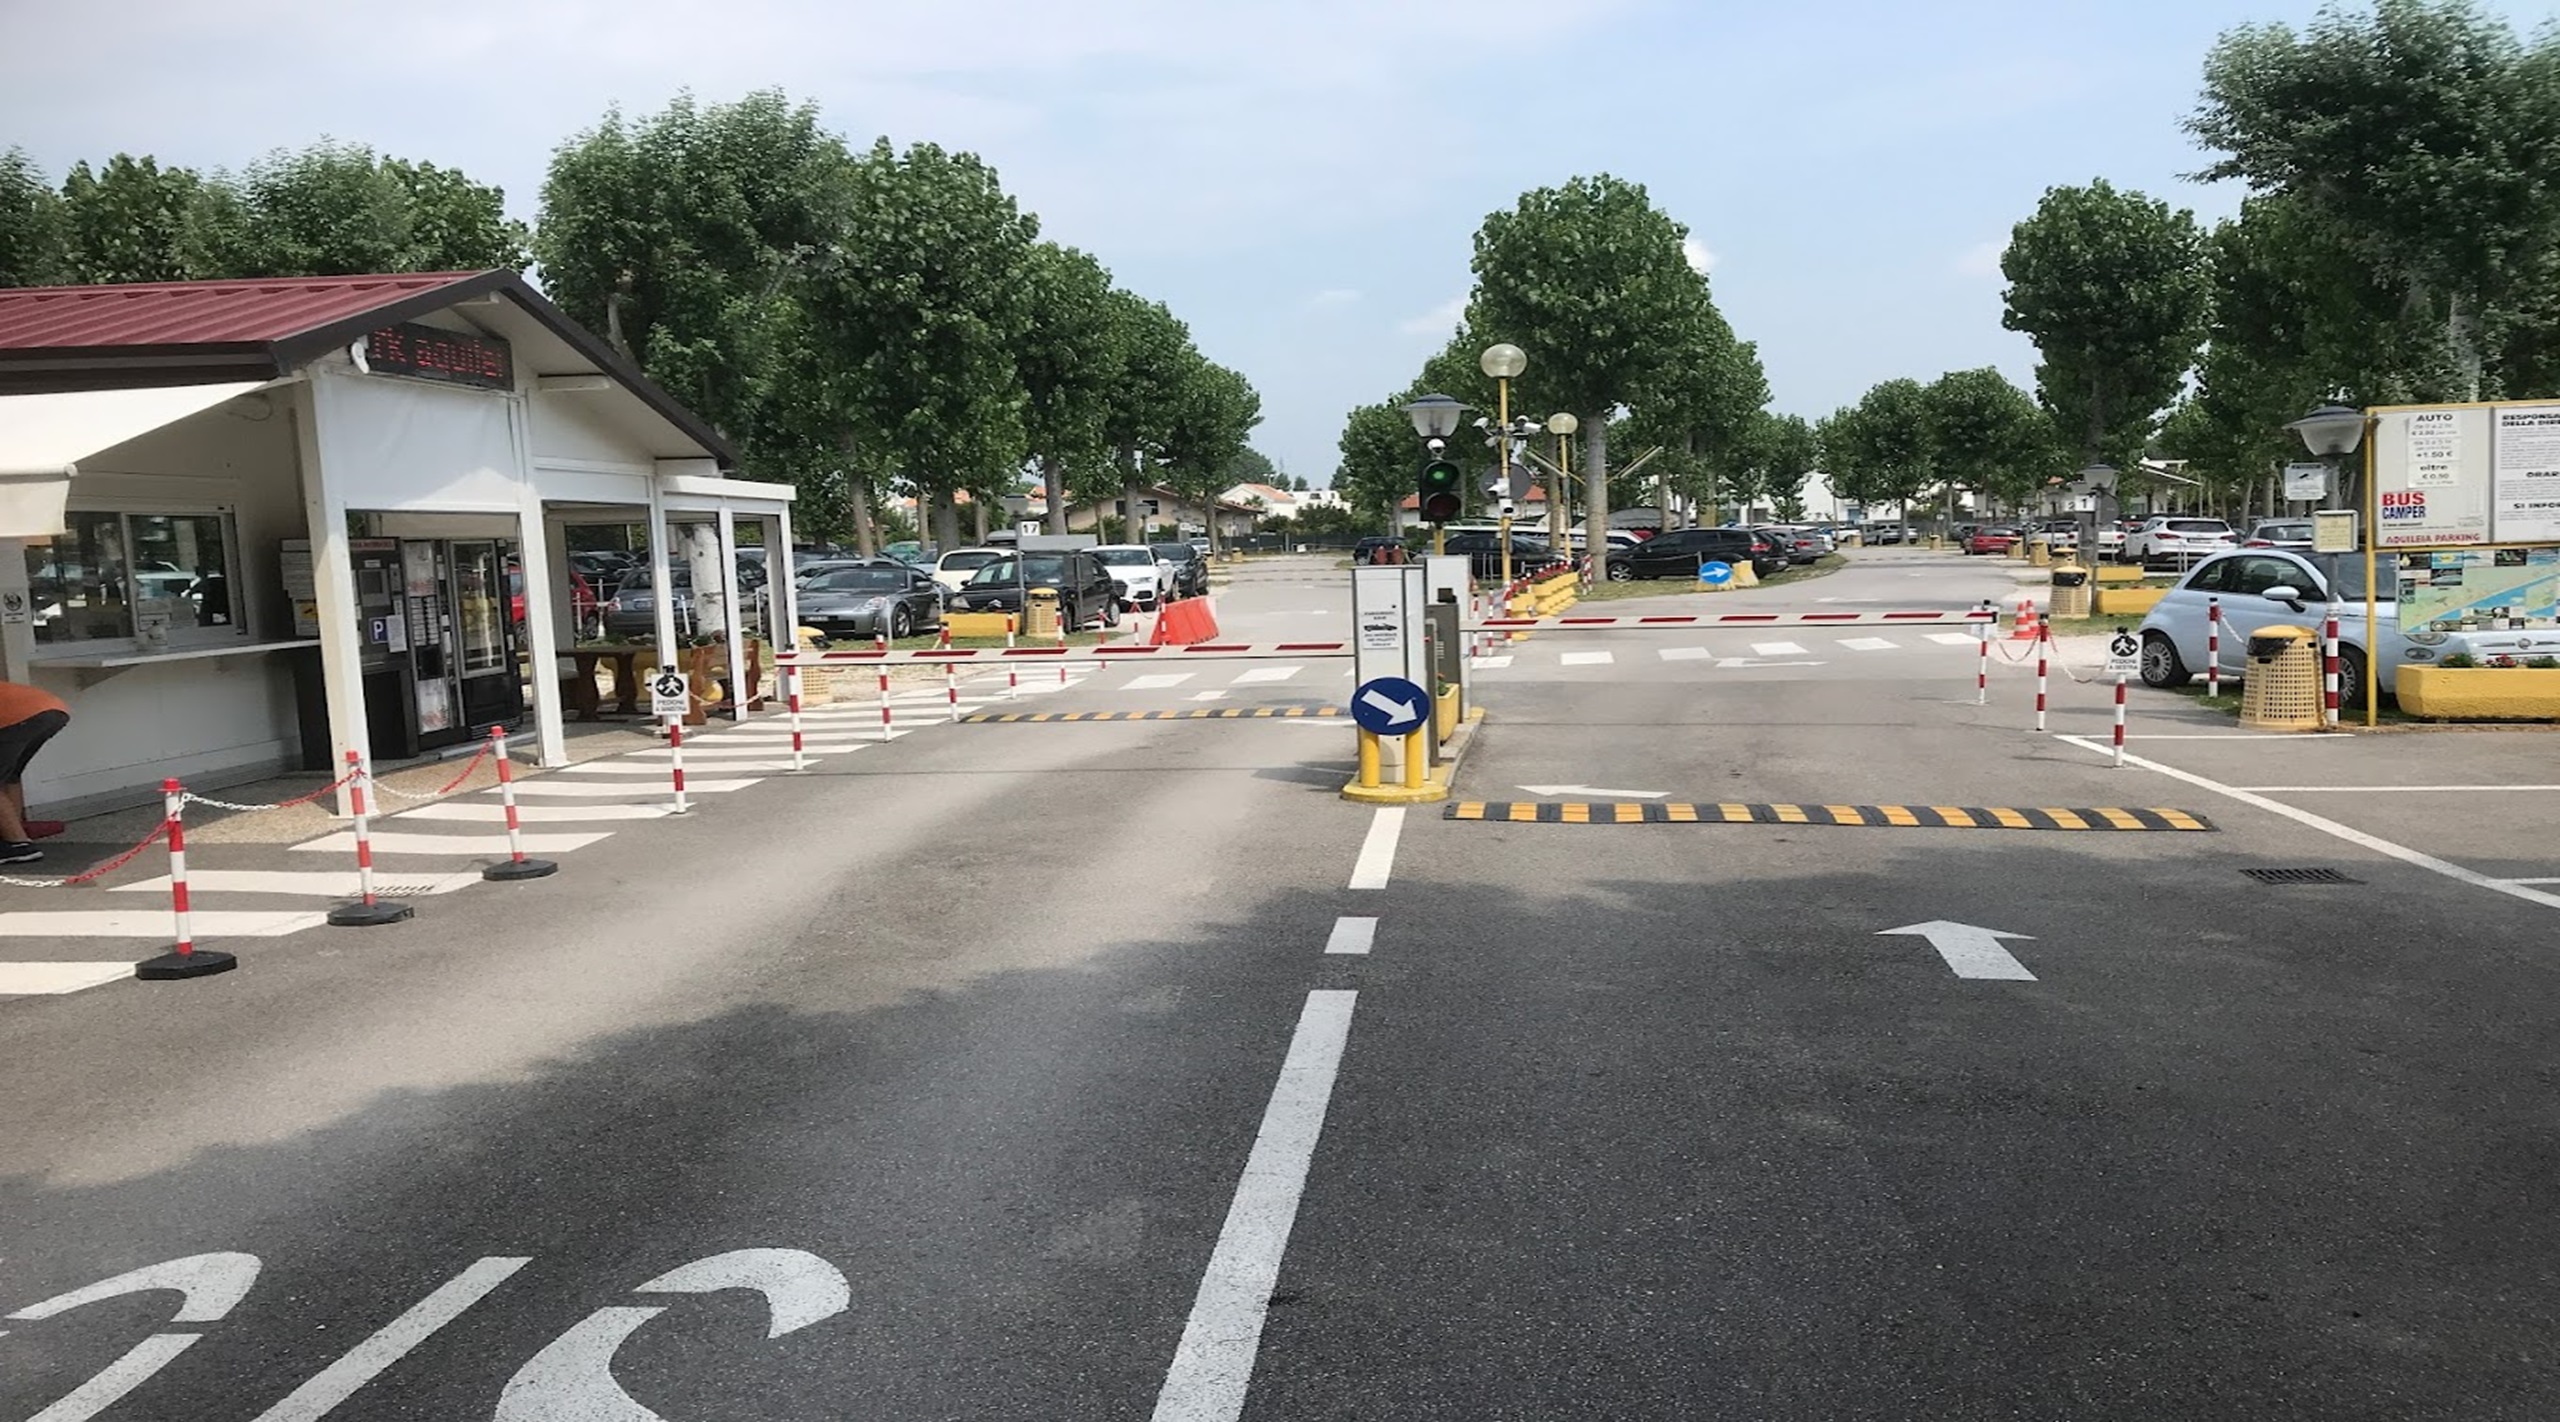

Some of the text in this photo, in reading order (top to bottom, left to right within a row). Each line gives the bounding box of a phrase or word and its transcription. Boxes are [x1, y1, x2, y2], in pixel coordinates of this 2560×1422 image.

[2417, 413, 2453, 422] AUTO
[2382, 492, 2425, 506] BUS
[2382, 506, 2426, 519] CAMPER
[1022, 523, 1039, 534] 17
[2386, 533, 2480, 544] AQUILEIA PARKING
[373, 621, 384, 640] P
